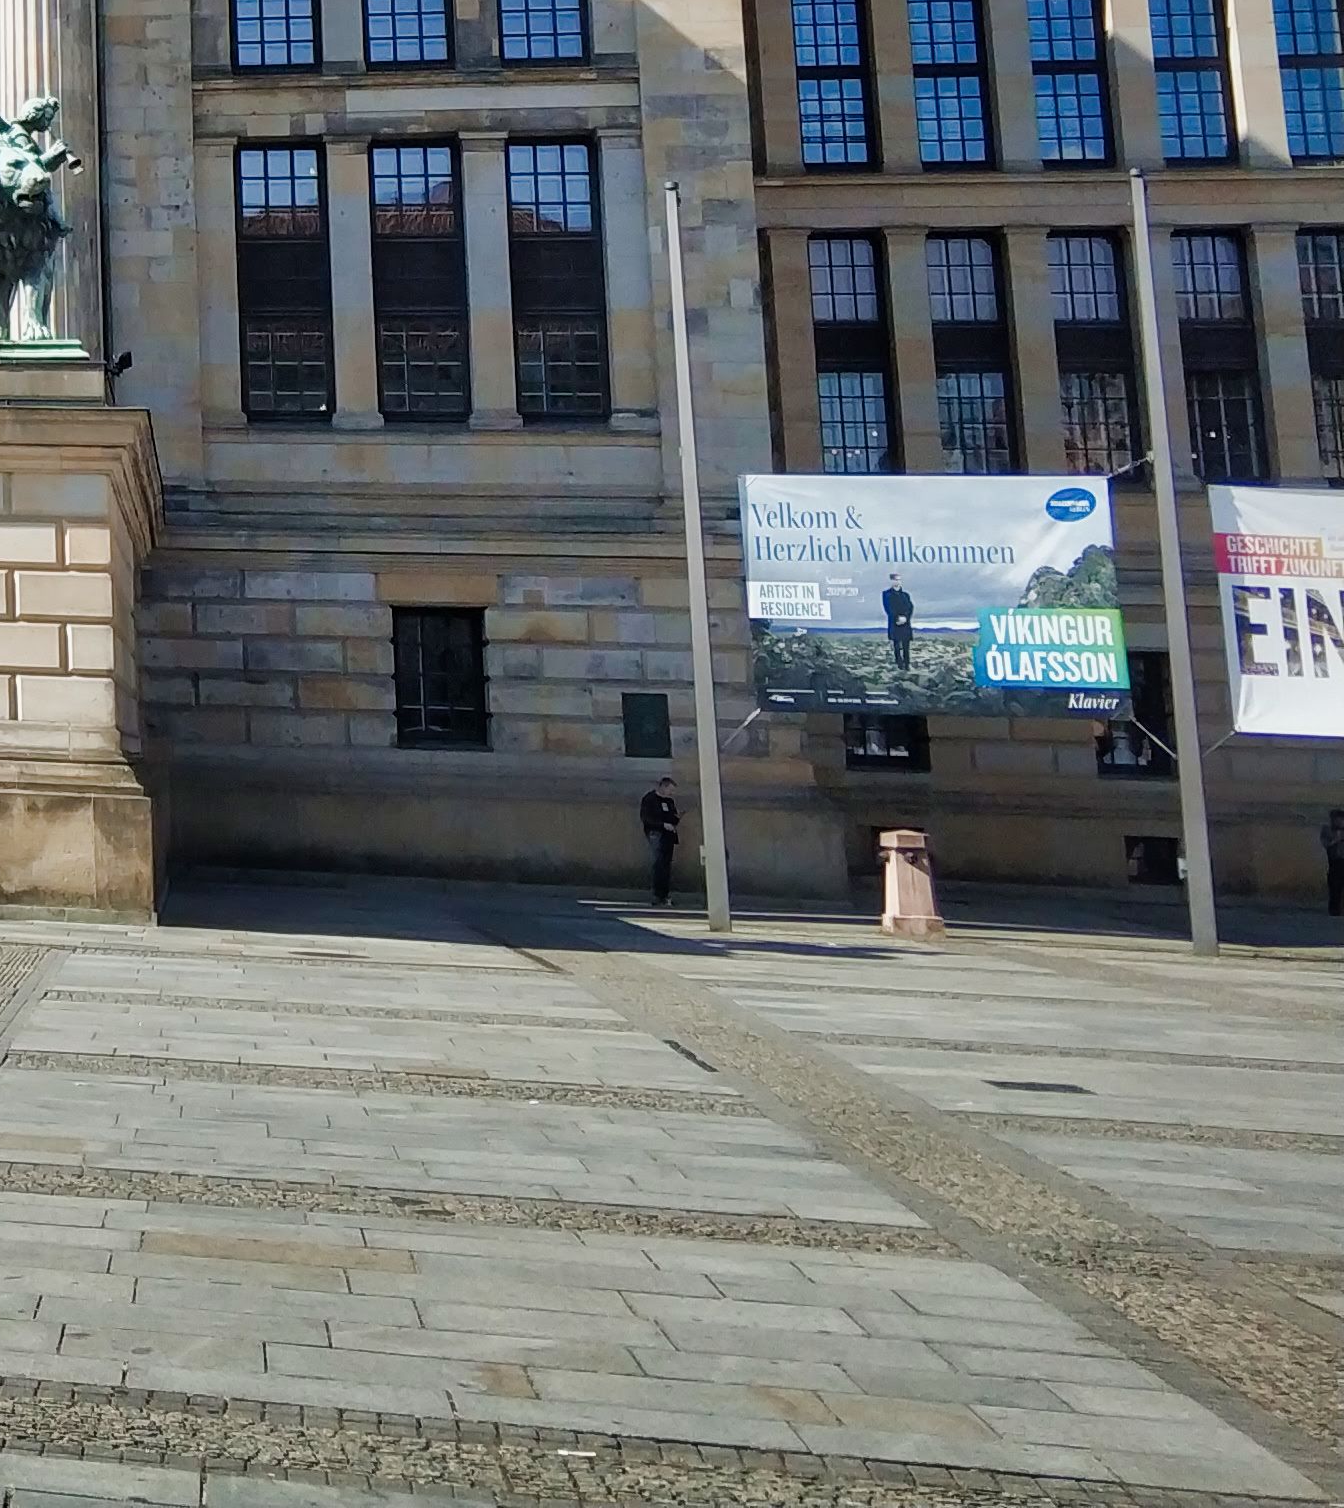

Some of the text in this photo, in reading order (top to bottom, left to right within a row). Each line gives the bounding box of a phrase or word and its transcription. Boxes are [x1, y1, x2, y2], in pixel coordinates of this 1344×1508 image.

[751, 502, 864, 530] Velkom &
[753, 535, 1015, 564] Herzlich Willkommen
[1226, 535, 1319, 557] GESCHICHTE
[1227, 555, 1344, 578] TRIFFT ZUKUNF
[759, 584, 815, 599] ARTIST IN
[760, 601, 826, 617] RESIDENCE
[990, 608, 1114, 646] VÍKINGUR
[986, 644, 1118, 683] ÓLAFSSON
[1068, 692, 1119, 710] Klavier
